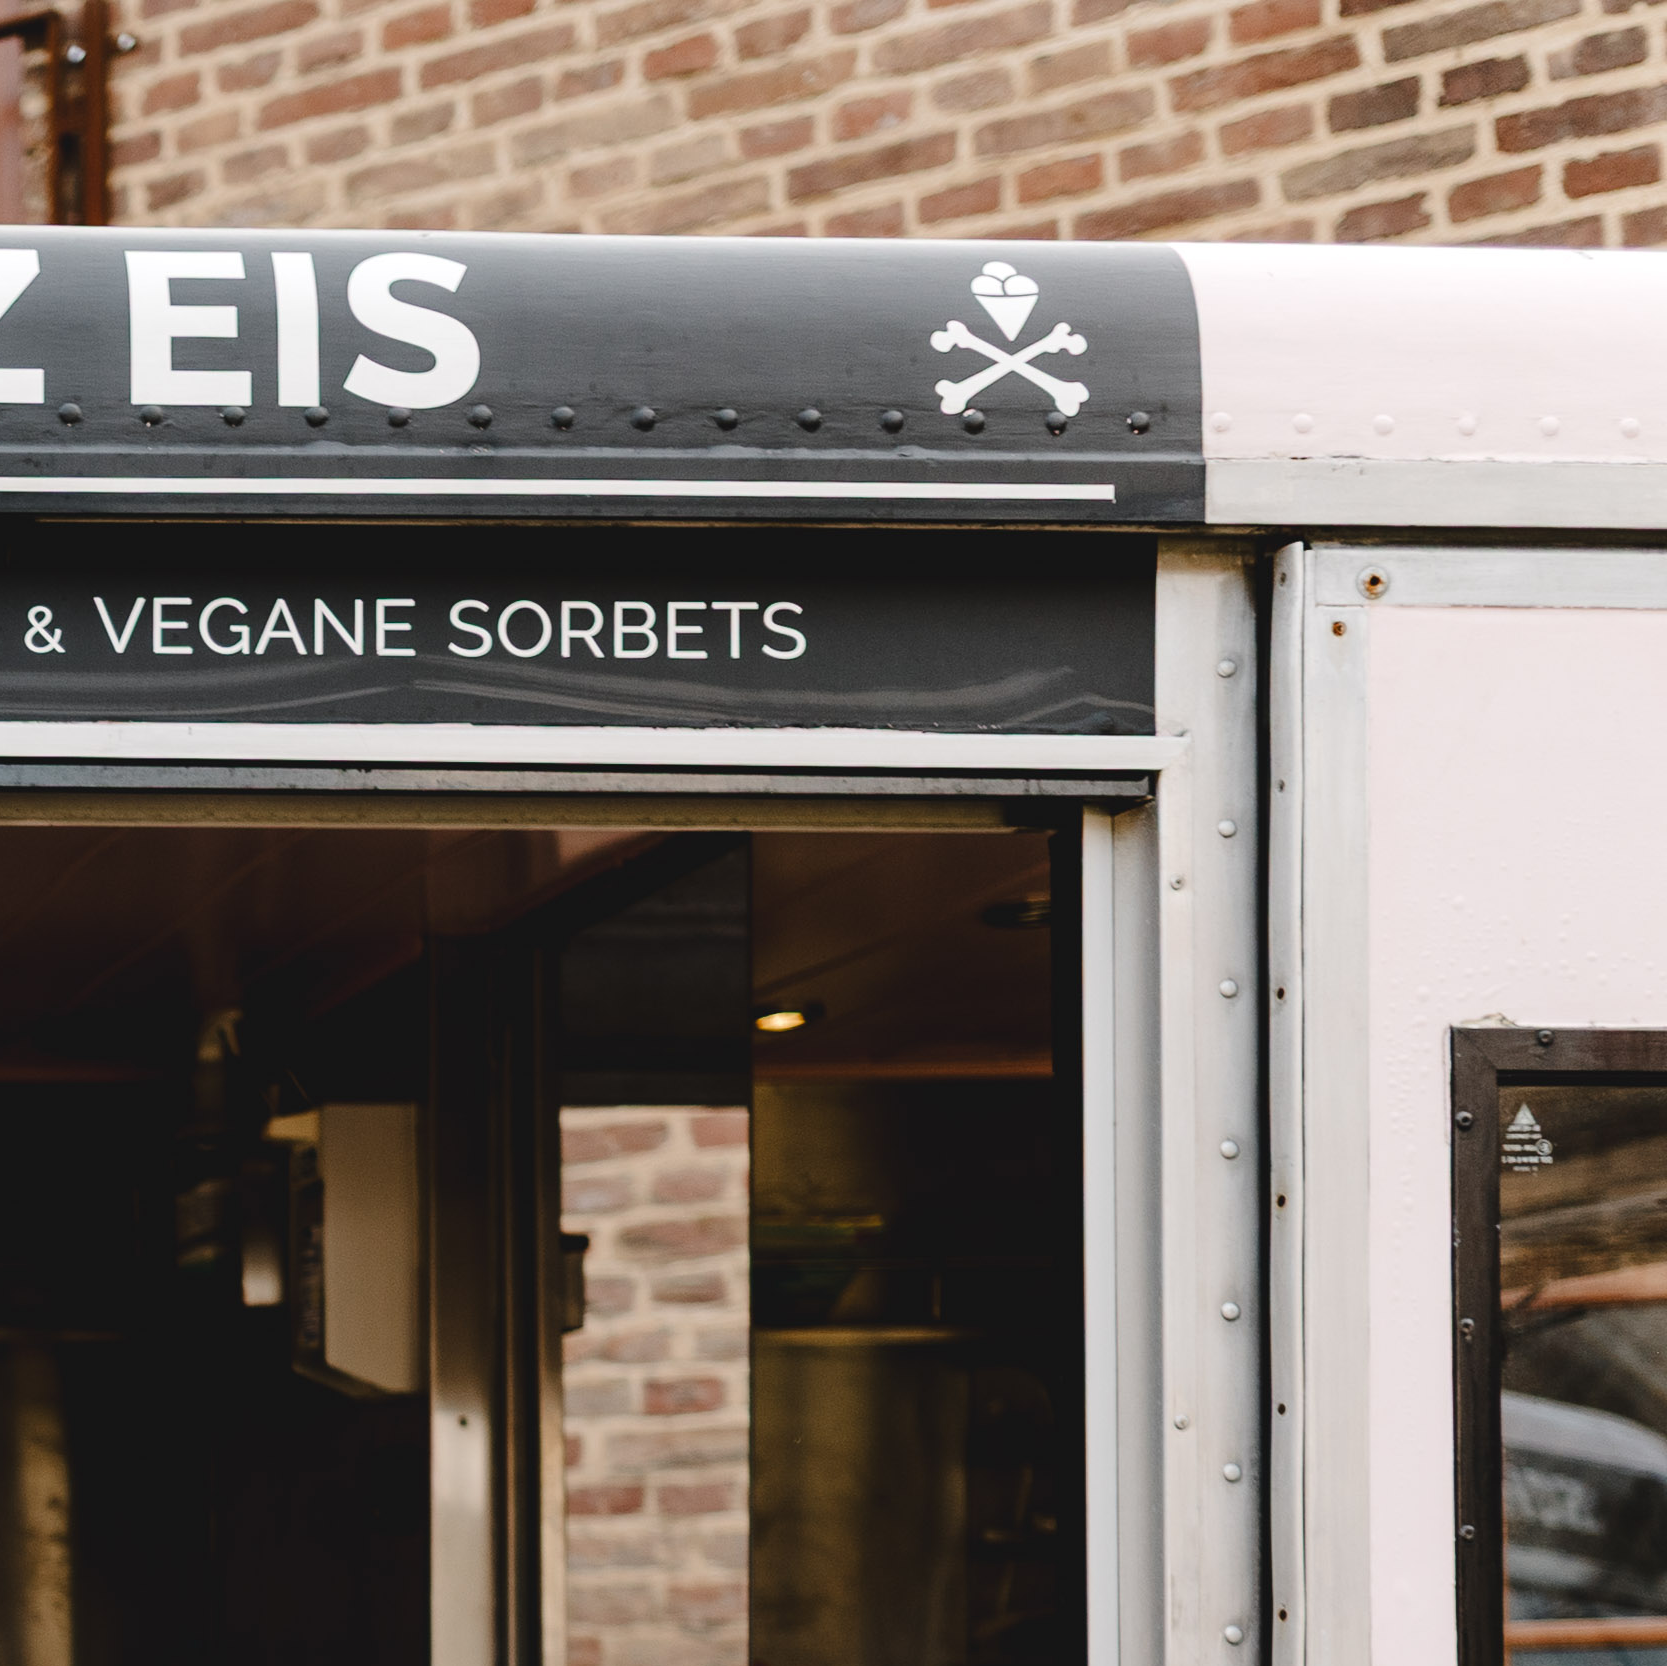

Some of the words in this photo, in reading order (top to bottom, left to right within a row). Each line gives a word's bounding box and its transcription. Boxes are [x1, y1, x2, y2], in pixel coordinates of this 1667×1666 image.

[123, 249, 482, 410] EIS
[25, 606, 65, 653] &
[94, 597, 415, 656] VEGANE
[449, 600, 806, 659] SORBETS
